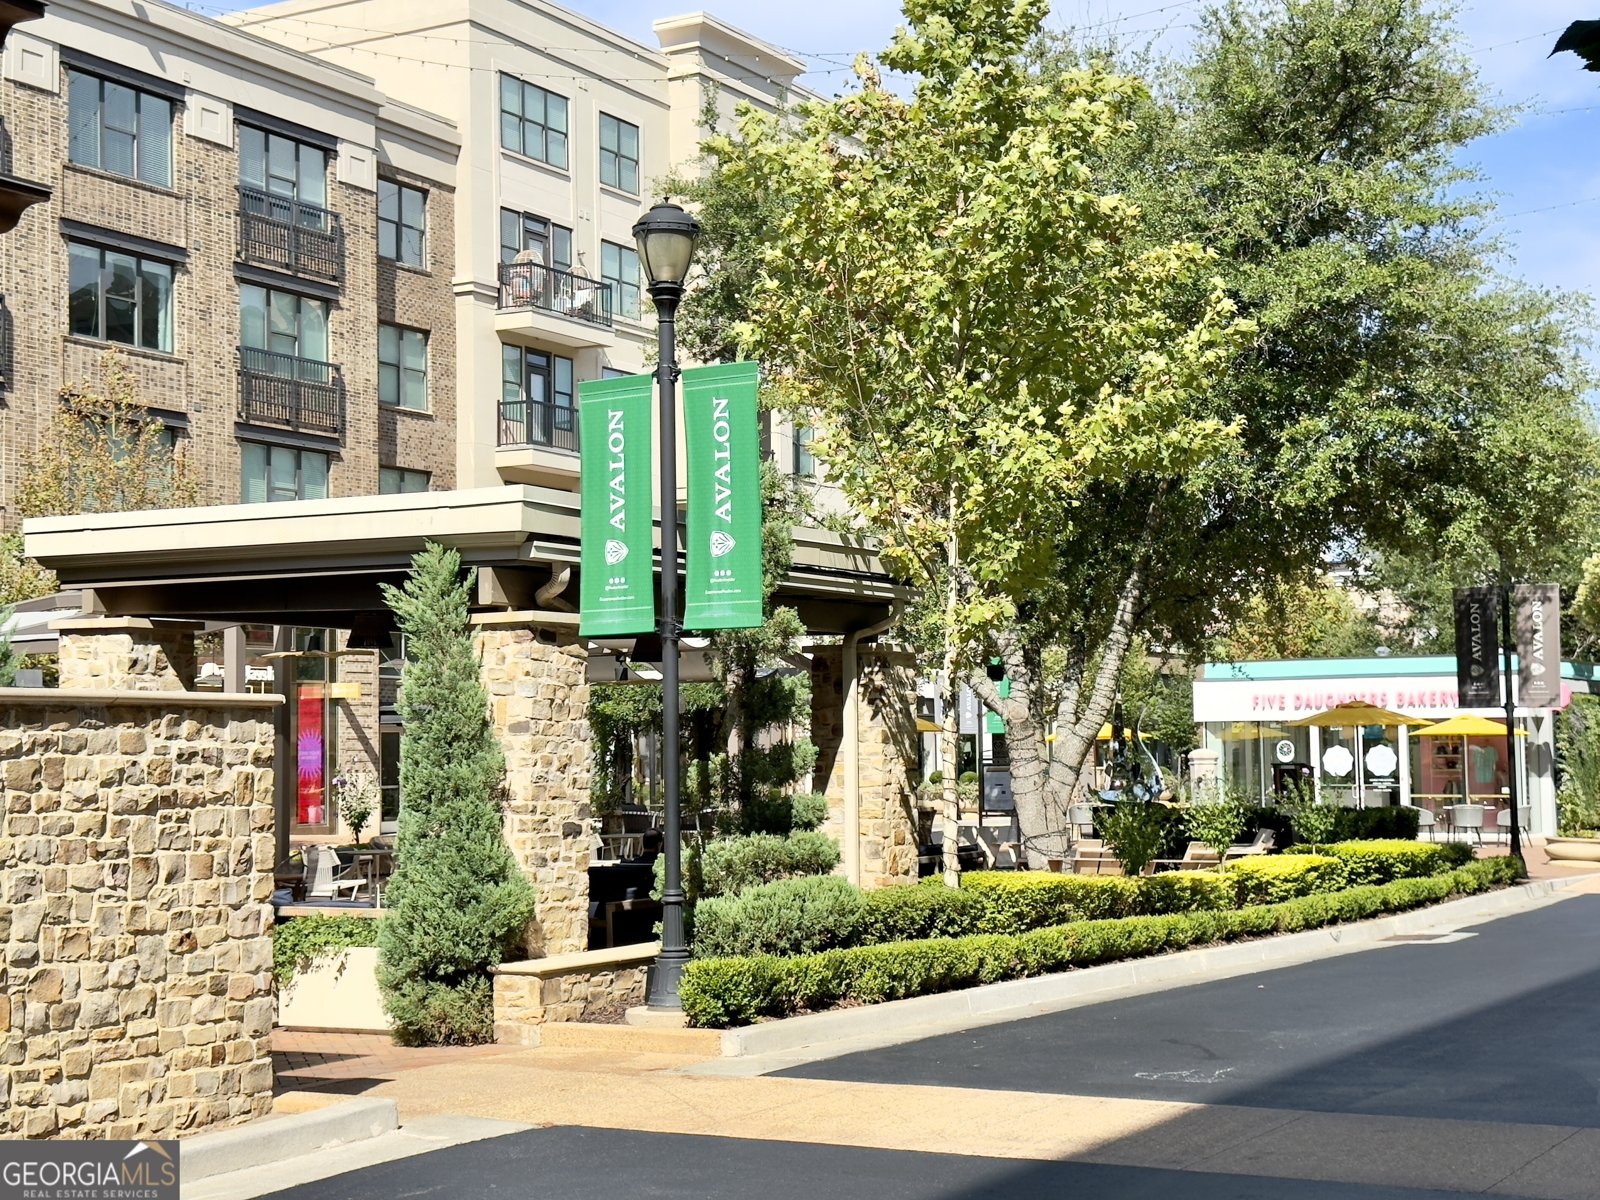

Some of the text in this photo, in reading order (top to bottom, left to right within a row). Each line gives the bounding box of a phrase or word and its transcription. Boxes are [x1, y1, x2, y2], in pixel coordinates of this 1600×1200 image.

[608, 409, 626, 533] AVALON
[713, 397, 732, 524] AVALON
[1470, 603, 1482, 661] AVALON
[1532, 600, 1544, 660] AVALON
[1252, 692, 1286, 711] FIVE
